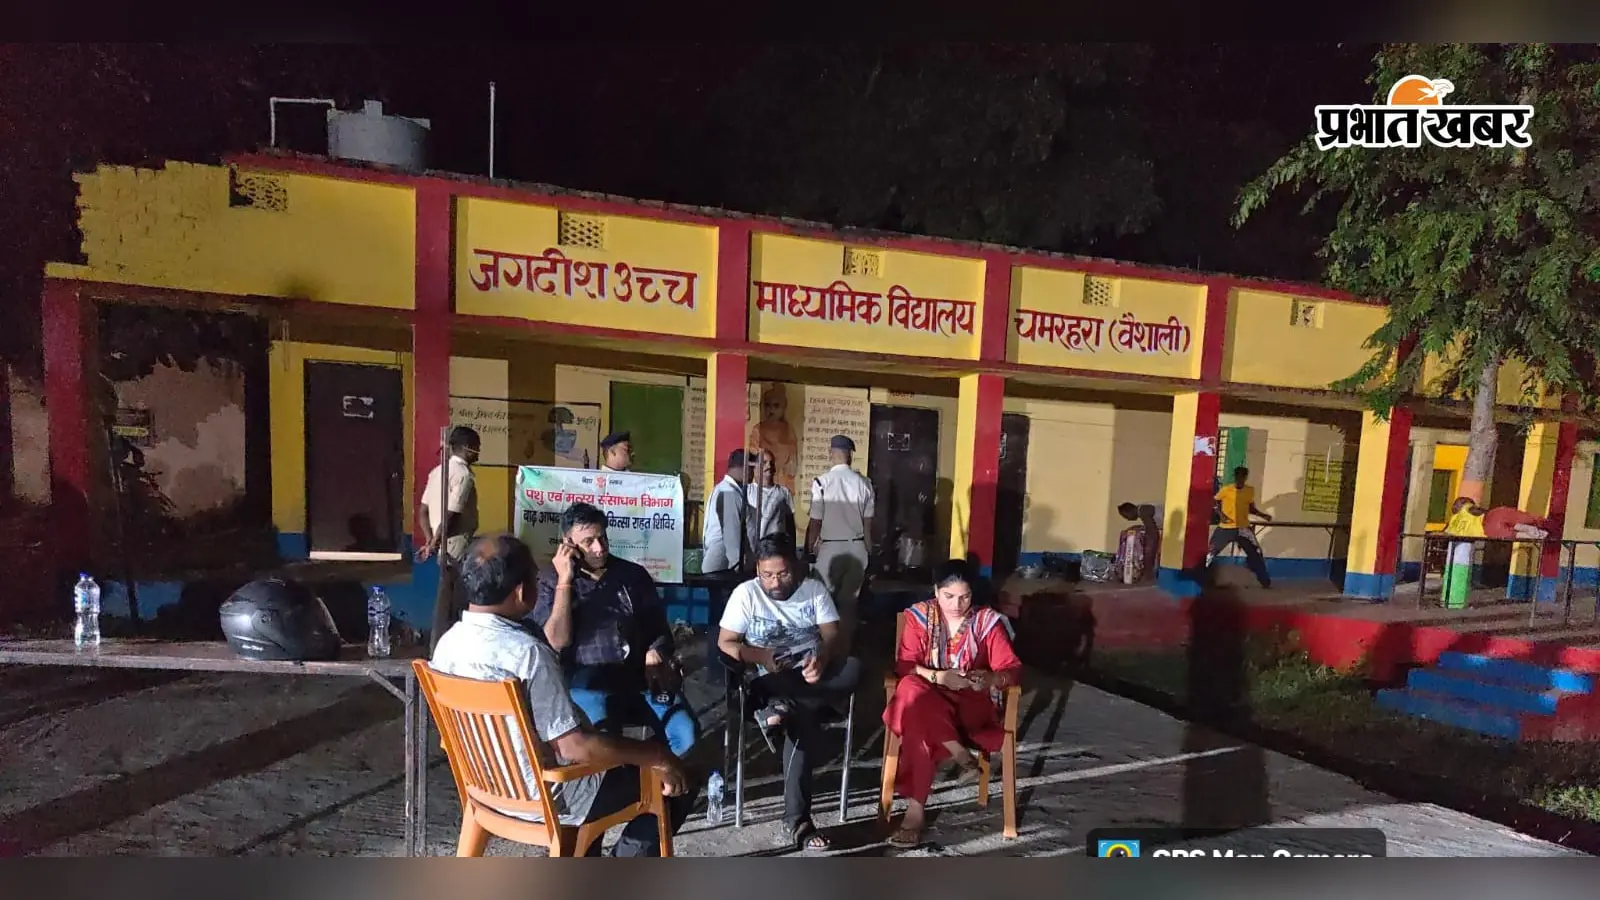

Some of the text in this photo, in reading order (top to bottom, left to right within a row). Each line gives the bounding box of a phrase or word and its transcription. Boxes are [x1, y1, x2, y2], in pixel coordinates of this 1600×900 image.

[468, 247, 698, 311] जगदीश उच्च
[753, 280, 977, 337] माध्यमिक विद्यालय
[1013, 309, 1191, 356] चमरहरा (वैशाली)
[525, 488, 674, 508] पशु एवं मत्स्य संसाधन विभाग
[538, 510, 563, 525] आपद
[632, 517, 652, 530] राहत
[652, 512, 675, 530] शिविर
